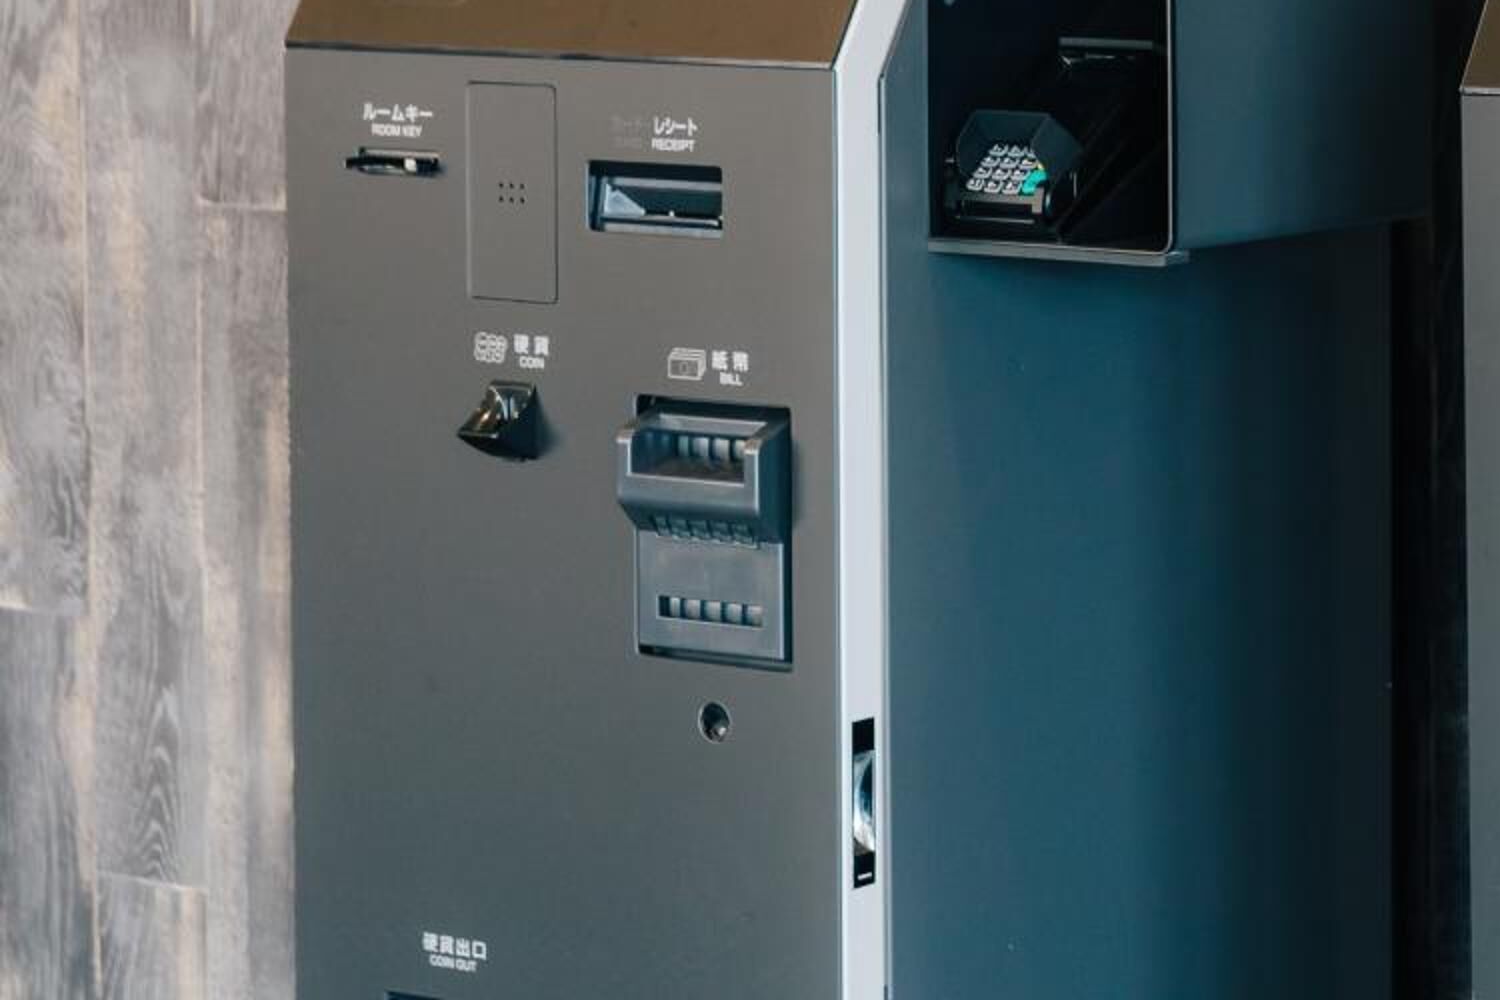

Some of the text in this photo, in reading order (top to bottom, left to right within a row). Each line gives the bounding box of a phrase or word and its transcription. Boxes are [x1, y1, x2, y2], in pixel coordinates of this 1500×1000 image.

[362, 103, 433, 122] ルームキー
[651, 137, 695, 152] RECEIPT
[519, 356, 544, 369] COIN
[429, 954, 477, 972] COIN OUT
